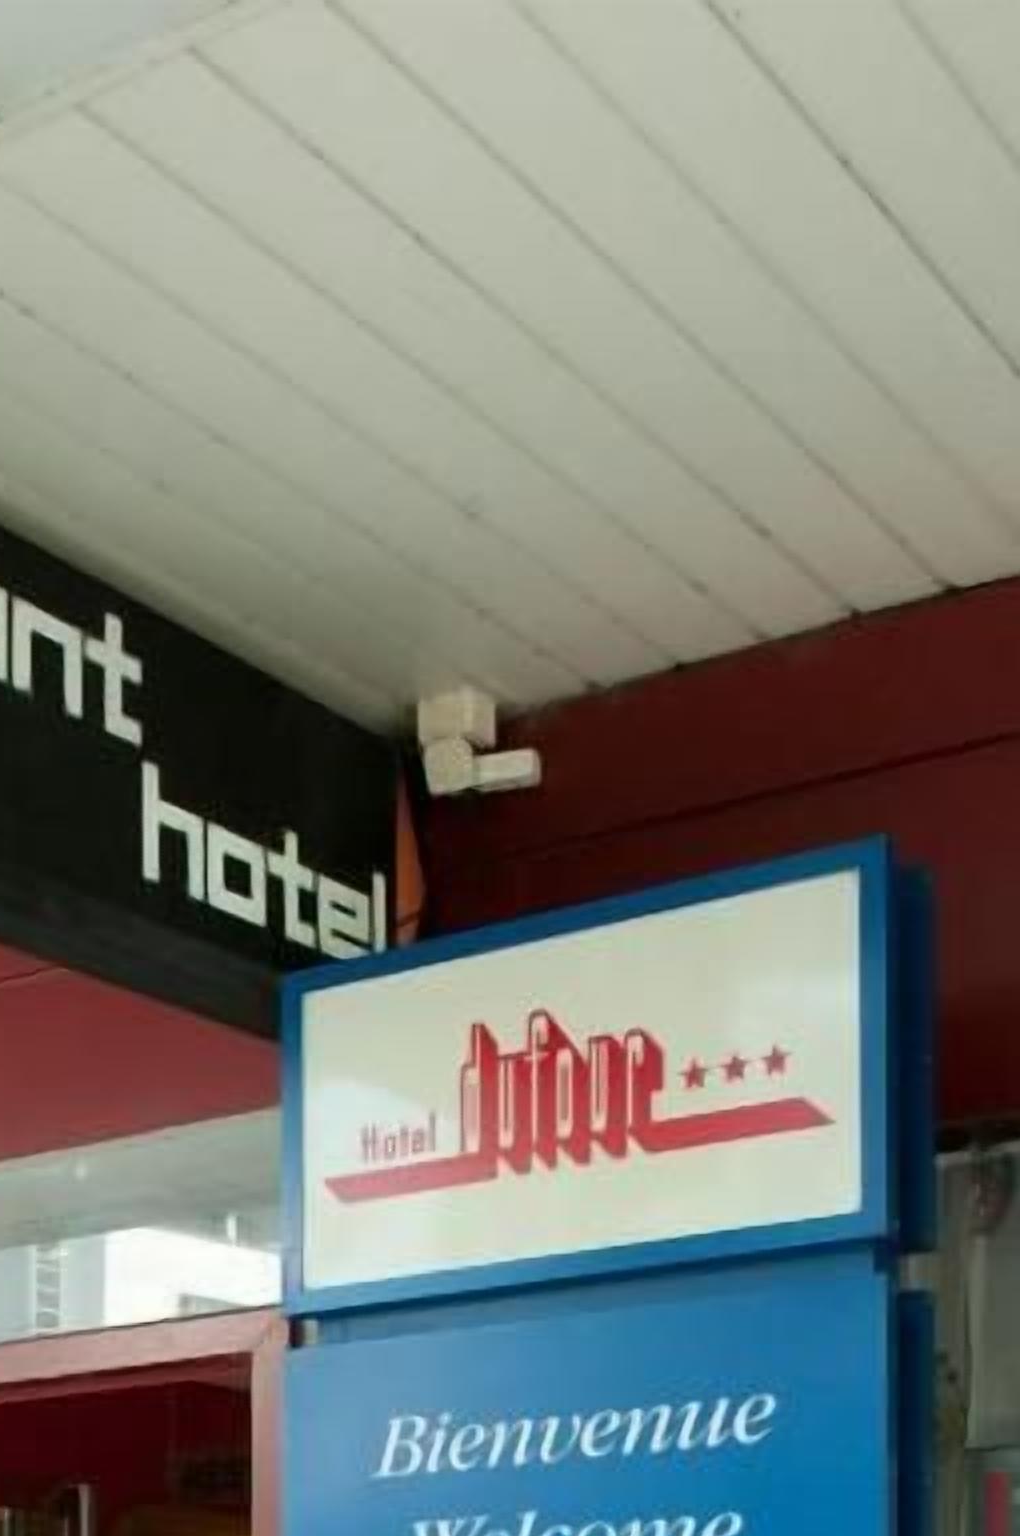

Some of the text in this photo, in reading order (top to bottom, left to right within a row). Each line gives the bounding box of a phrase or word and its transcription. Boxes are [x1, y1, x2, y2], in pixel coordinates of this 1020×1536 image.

[141, 760, 387, 960] hotel
[361, 1111, 437, 1163] Hotel
[372, 1391, 777, 1478] Bienvenue
